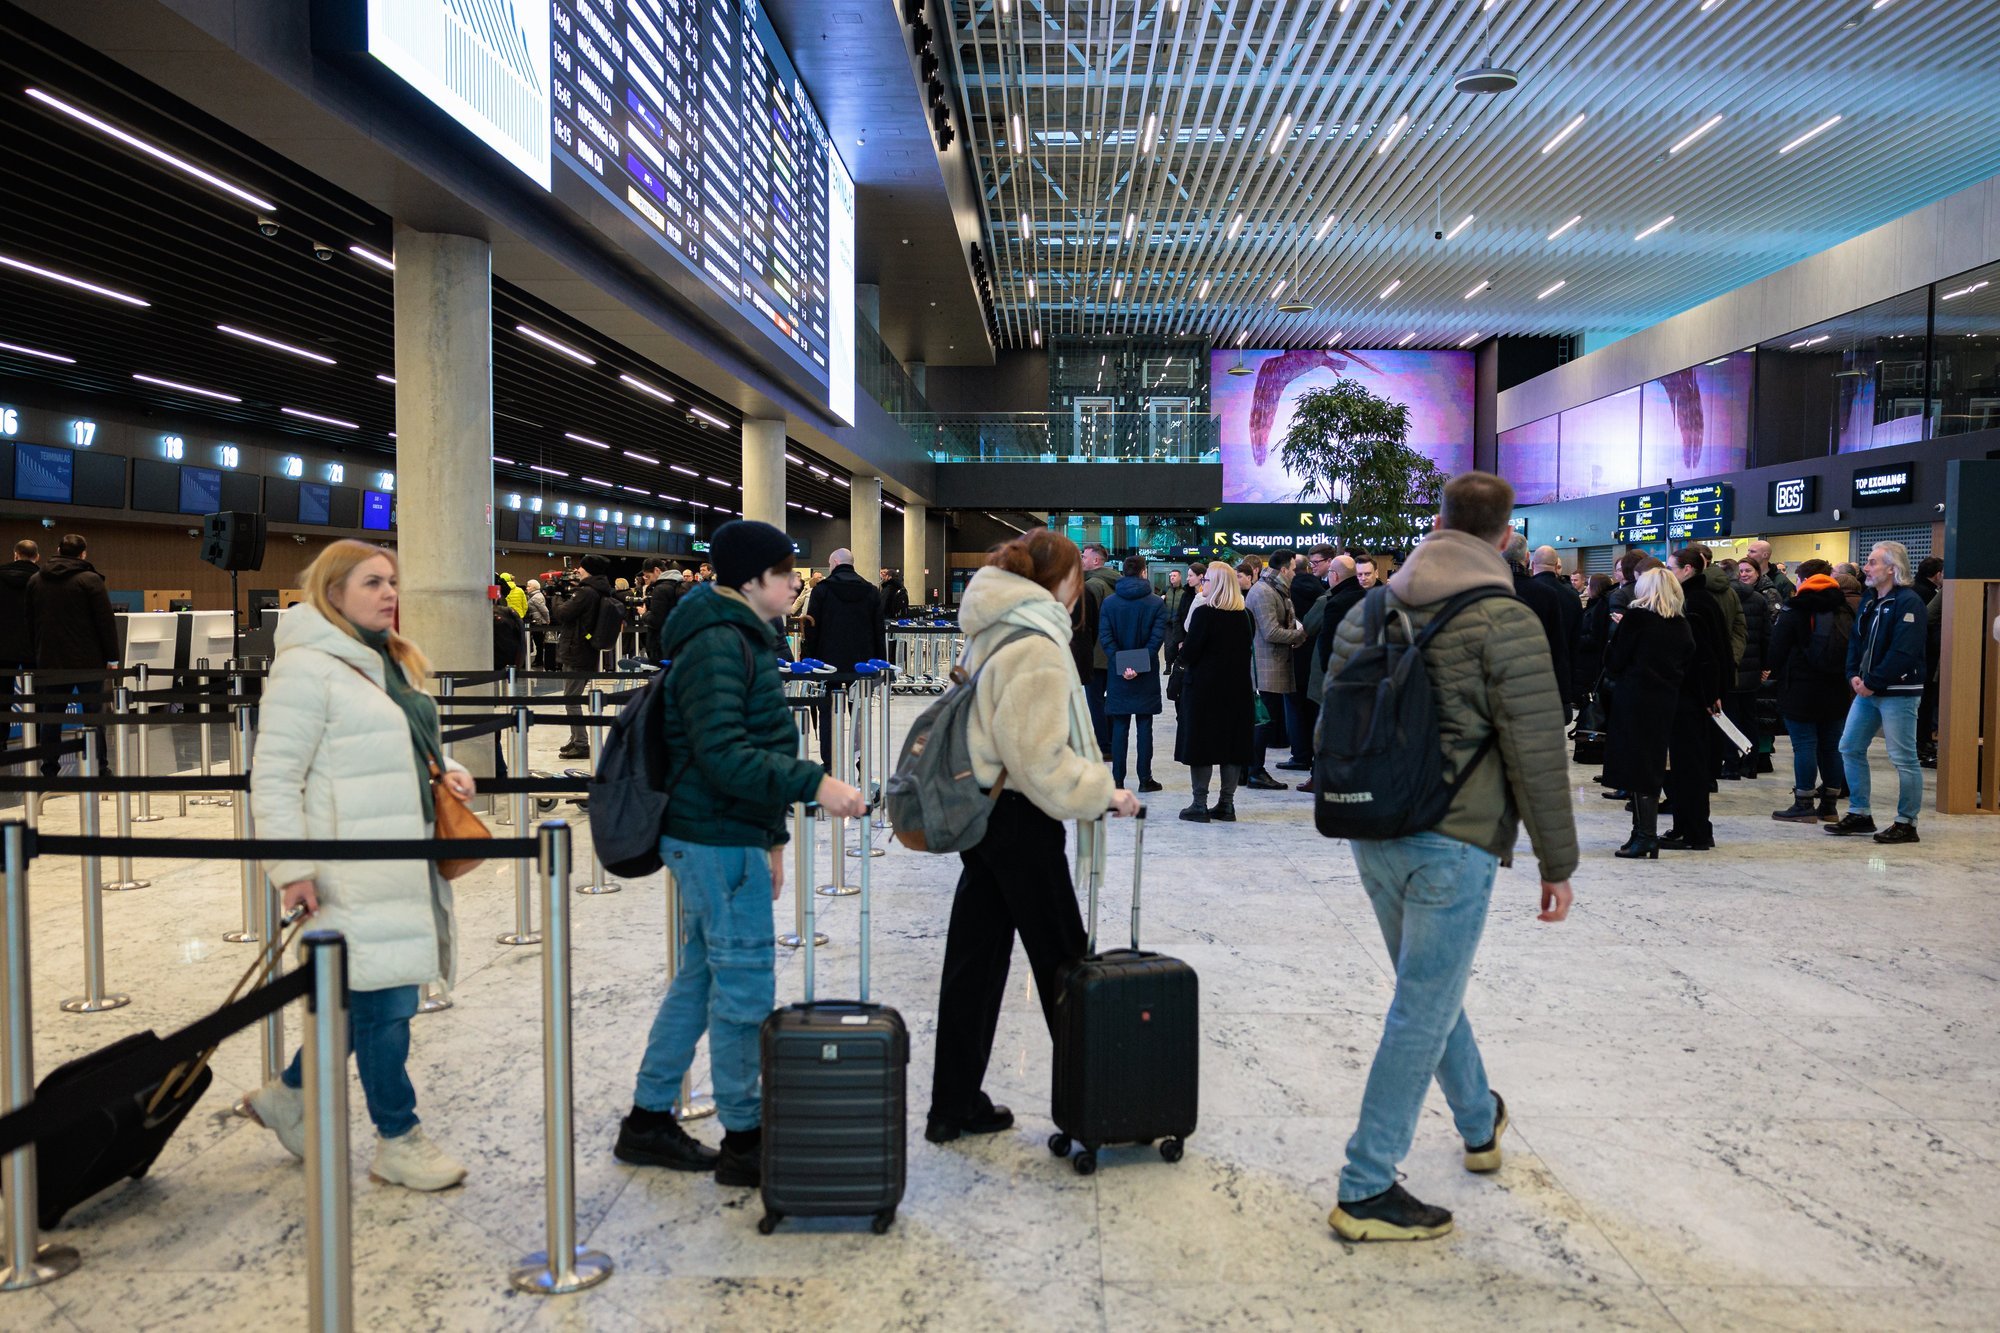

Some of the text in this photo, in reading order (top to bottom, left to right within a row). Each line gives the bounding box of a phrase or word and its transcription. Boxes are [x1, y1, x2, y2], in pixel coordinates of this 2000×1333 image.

[554, 113, 571, 145] 16:15
[0, 407, 17, 435] 16
[74, 421, 96, 446] 17
[40, 451, 71, 464] TERMINALAS
[165, 436, 183, 459] 18
[222, 446, 238, 468] 19
[288, 457, 302, 477] 20
[330, 464, 343, 483] 21
[381, 473, 394, 490] 22
[1855, 473, 1907, 490] TOP EXCHANGE
[1779, 486, 1800, 508] BGS
[1232, 532, 1293, 549] Saugumo
[1296, 532, 1342, 549] patik
[1323, 791, 1374, 804] HILFIGER
